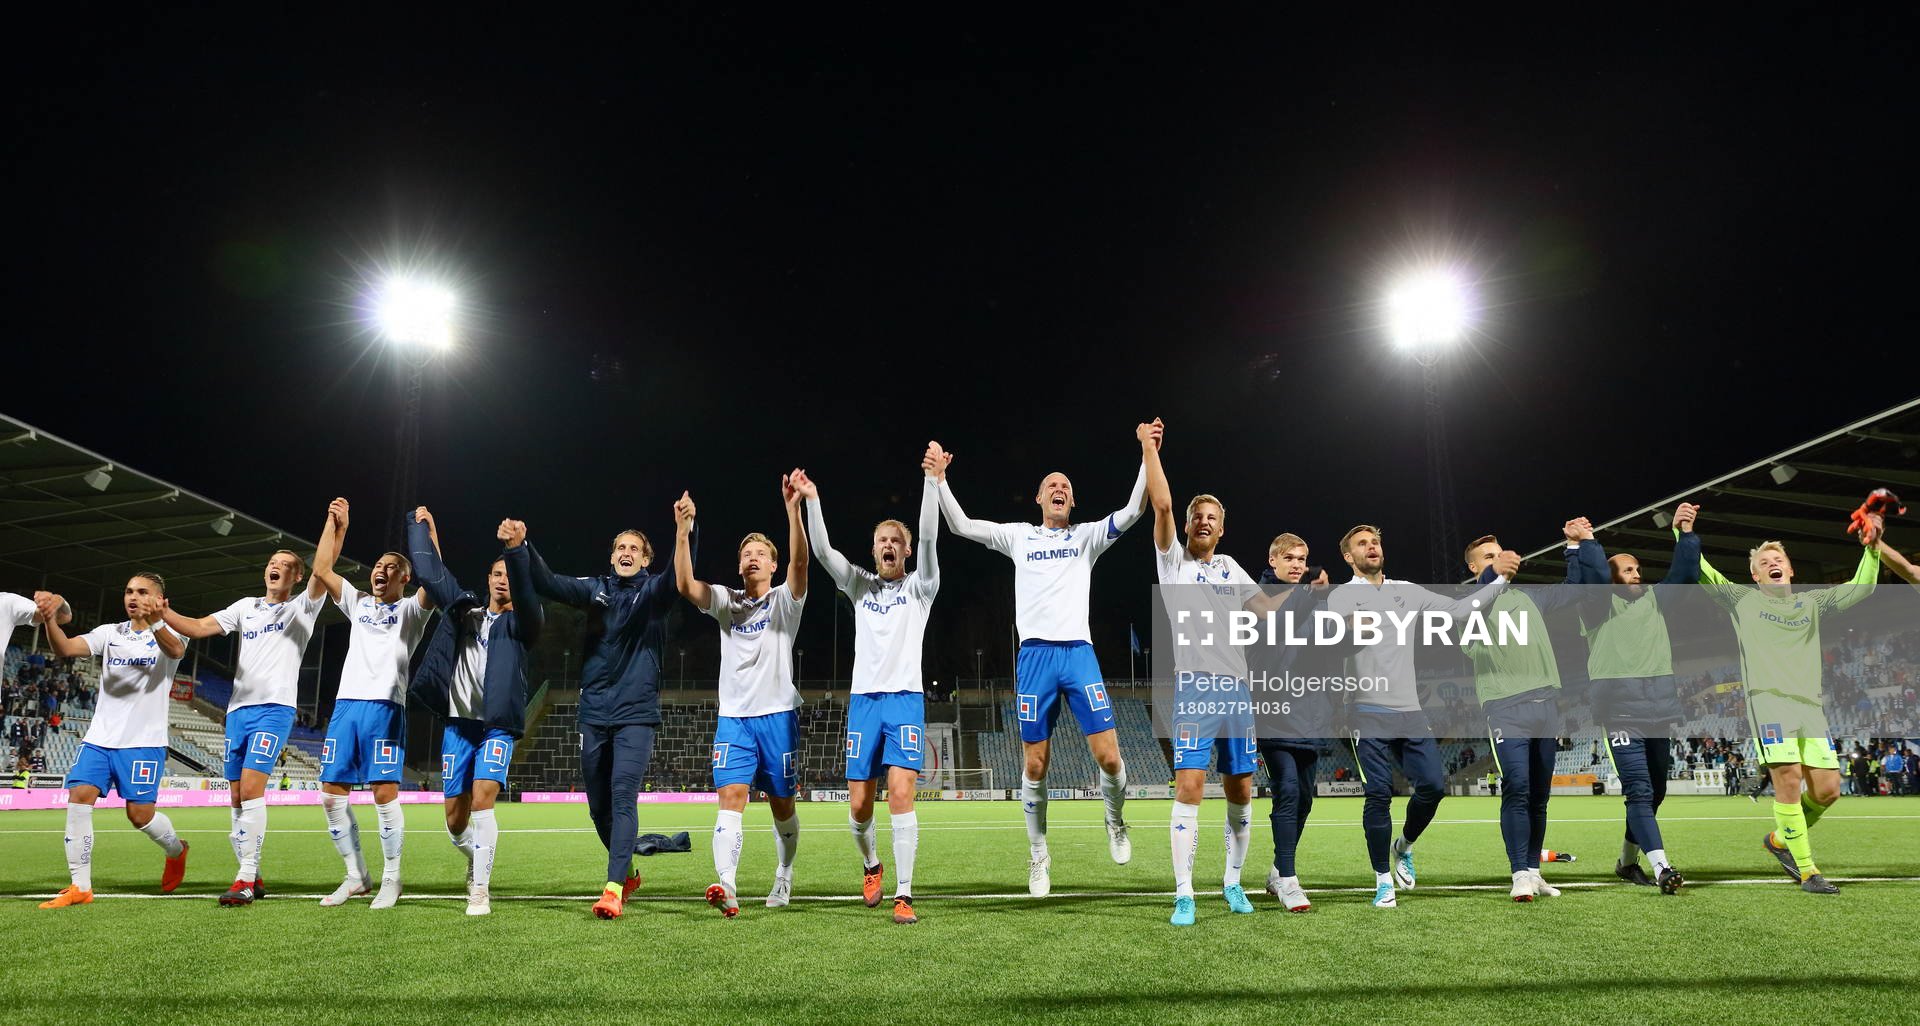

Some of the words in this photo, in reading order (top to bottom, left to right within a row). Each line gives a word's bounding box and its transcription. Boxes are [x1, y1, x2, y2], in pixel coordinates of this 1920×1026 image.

[1026, 548, 1079, 561] HOLMEN
[107, 656, 156, 667] HOLMEN
[1610, 731, 1631, 748] 20
[170, 779, 191, 790] Fiskeby
